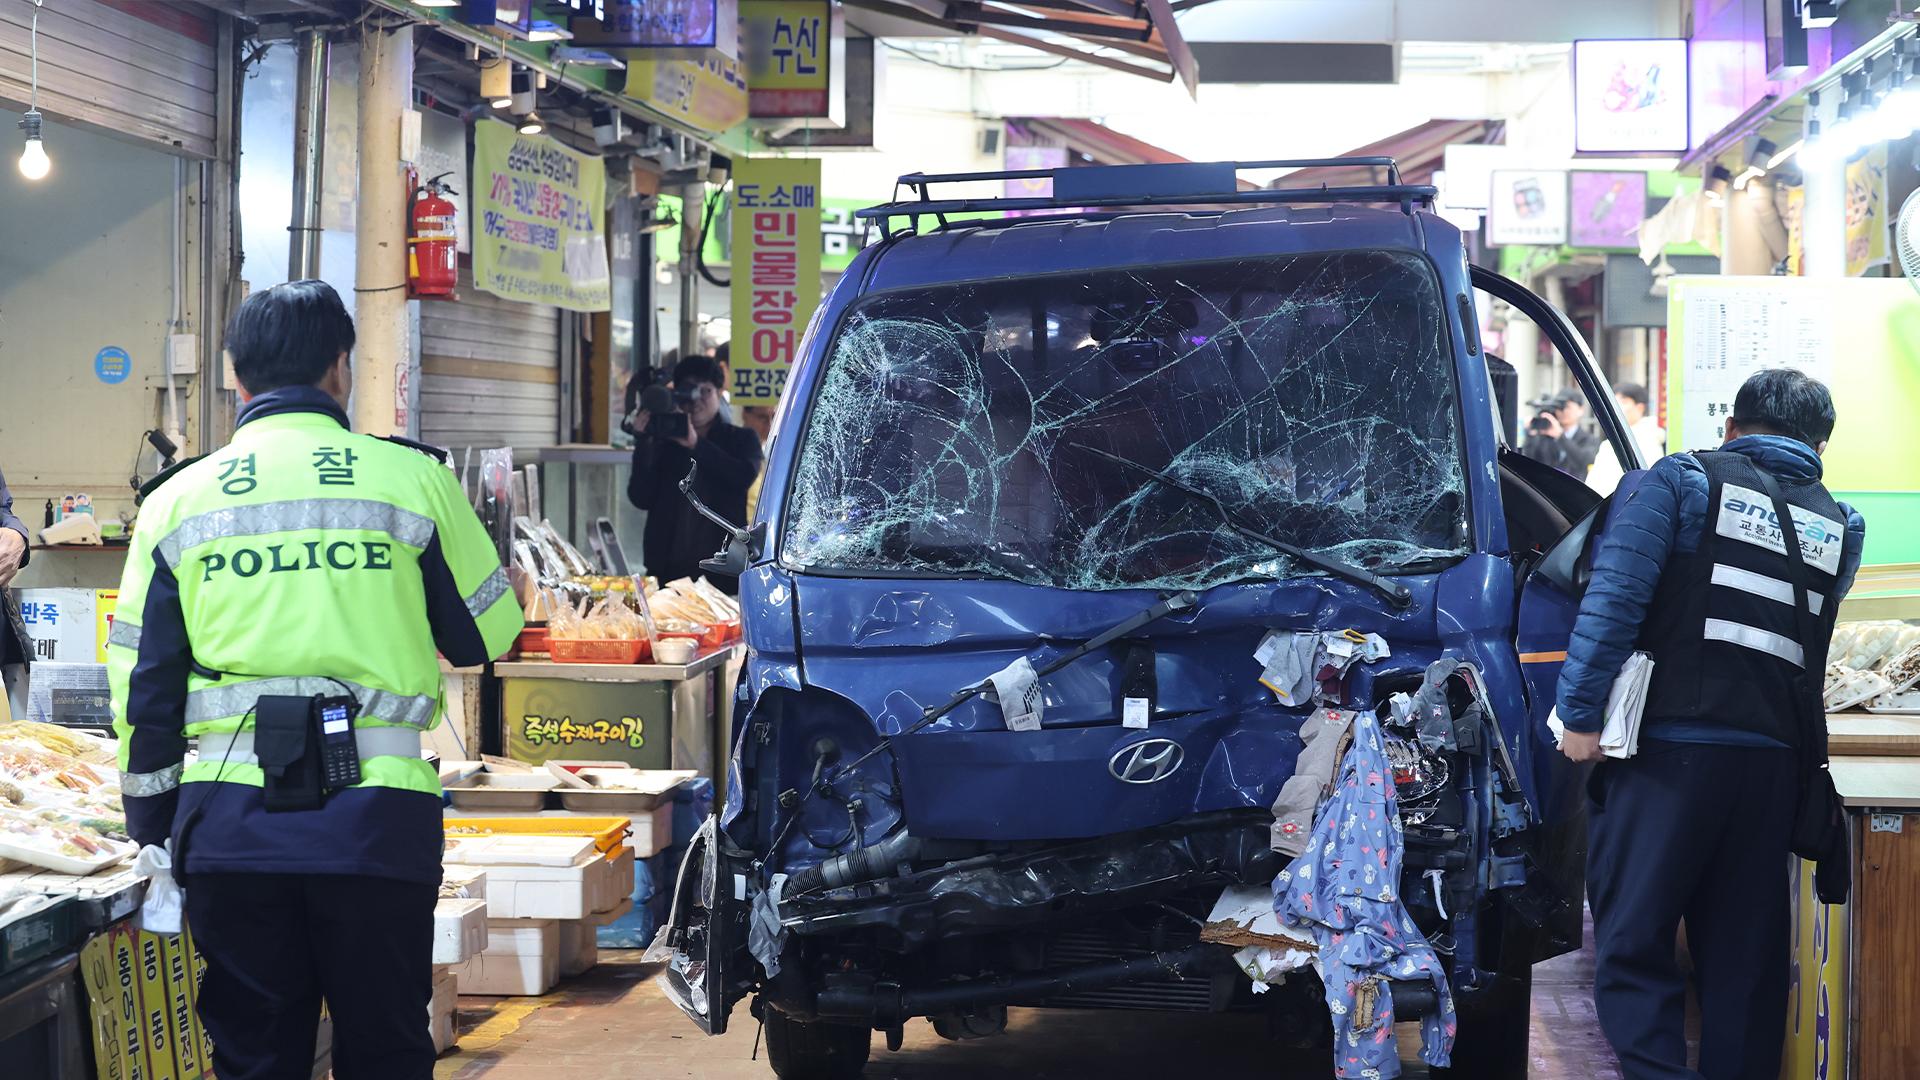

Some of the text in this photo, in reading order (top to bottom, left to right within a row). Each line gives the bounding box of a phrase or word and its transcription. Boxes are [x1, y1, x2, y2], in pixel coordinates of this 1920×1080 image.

[738, 184, 815, 208] 도.소매
[752, 212, 797, 364] 민물장어
[200, 541, 392, 582] POLICE
[21, 602, 60, 626] 반죽
[523, 714, 645, 749] 즉석수제구이김
